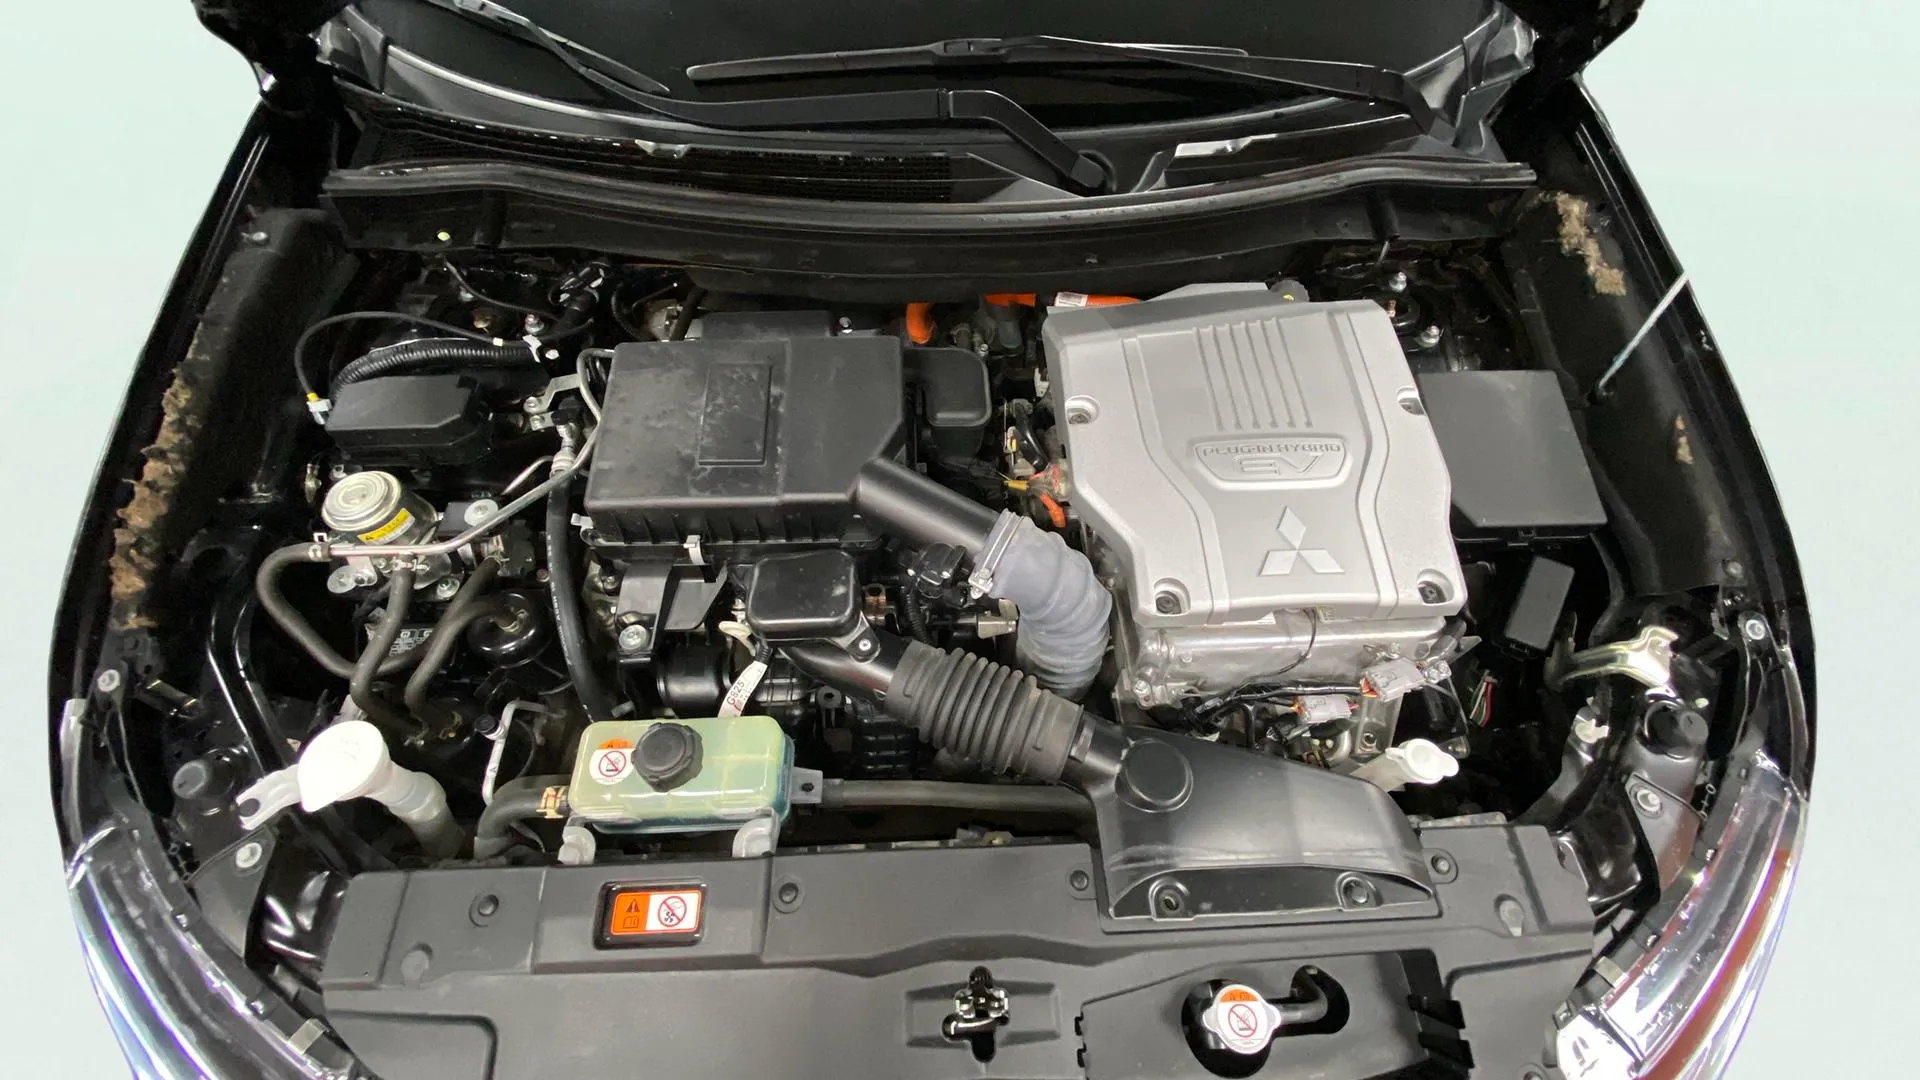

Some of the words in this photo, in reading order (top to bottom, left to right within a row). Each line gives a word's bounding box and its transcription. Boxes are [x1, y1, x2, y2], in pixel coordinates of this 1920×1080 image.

[1203, 445, 1273, 456] PLUG-IN
[1278, 443, 1341, 453] HYBRID
[1232, 453, 1323, 475] EV
